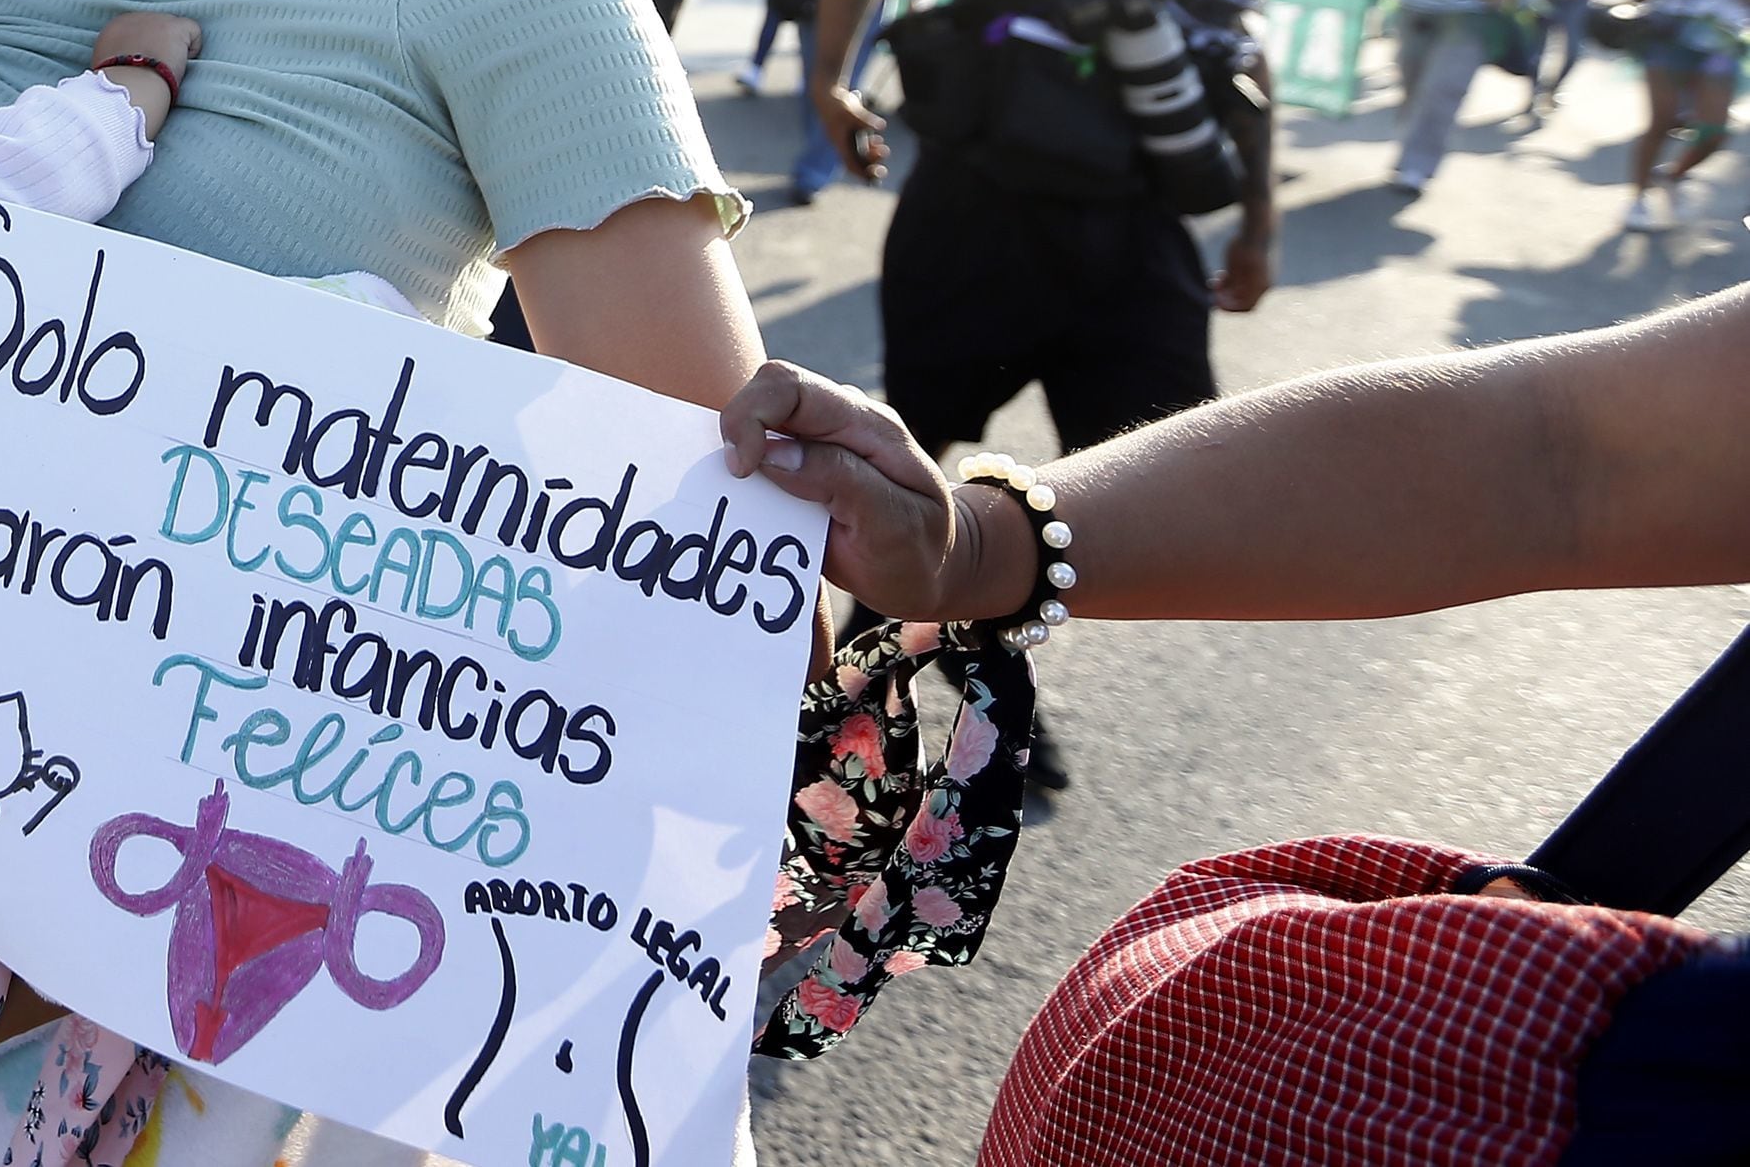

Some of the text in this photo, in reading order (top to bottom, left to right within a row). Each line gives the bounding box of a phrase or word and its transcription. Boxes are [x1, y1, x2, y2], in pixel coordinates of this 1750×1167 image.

[238, 592, 616, 784] infancias
[465, 878, 731, 1021] ABORTO LEGAL
